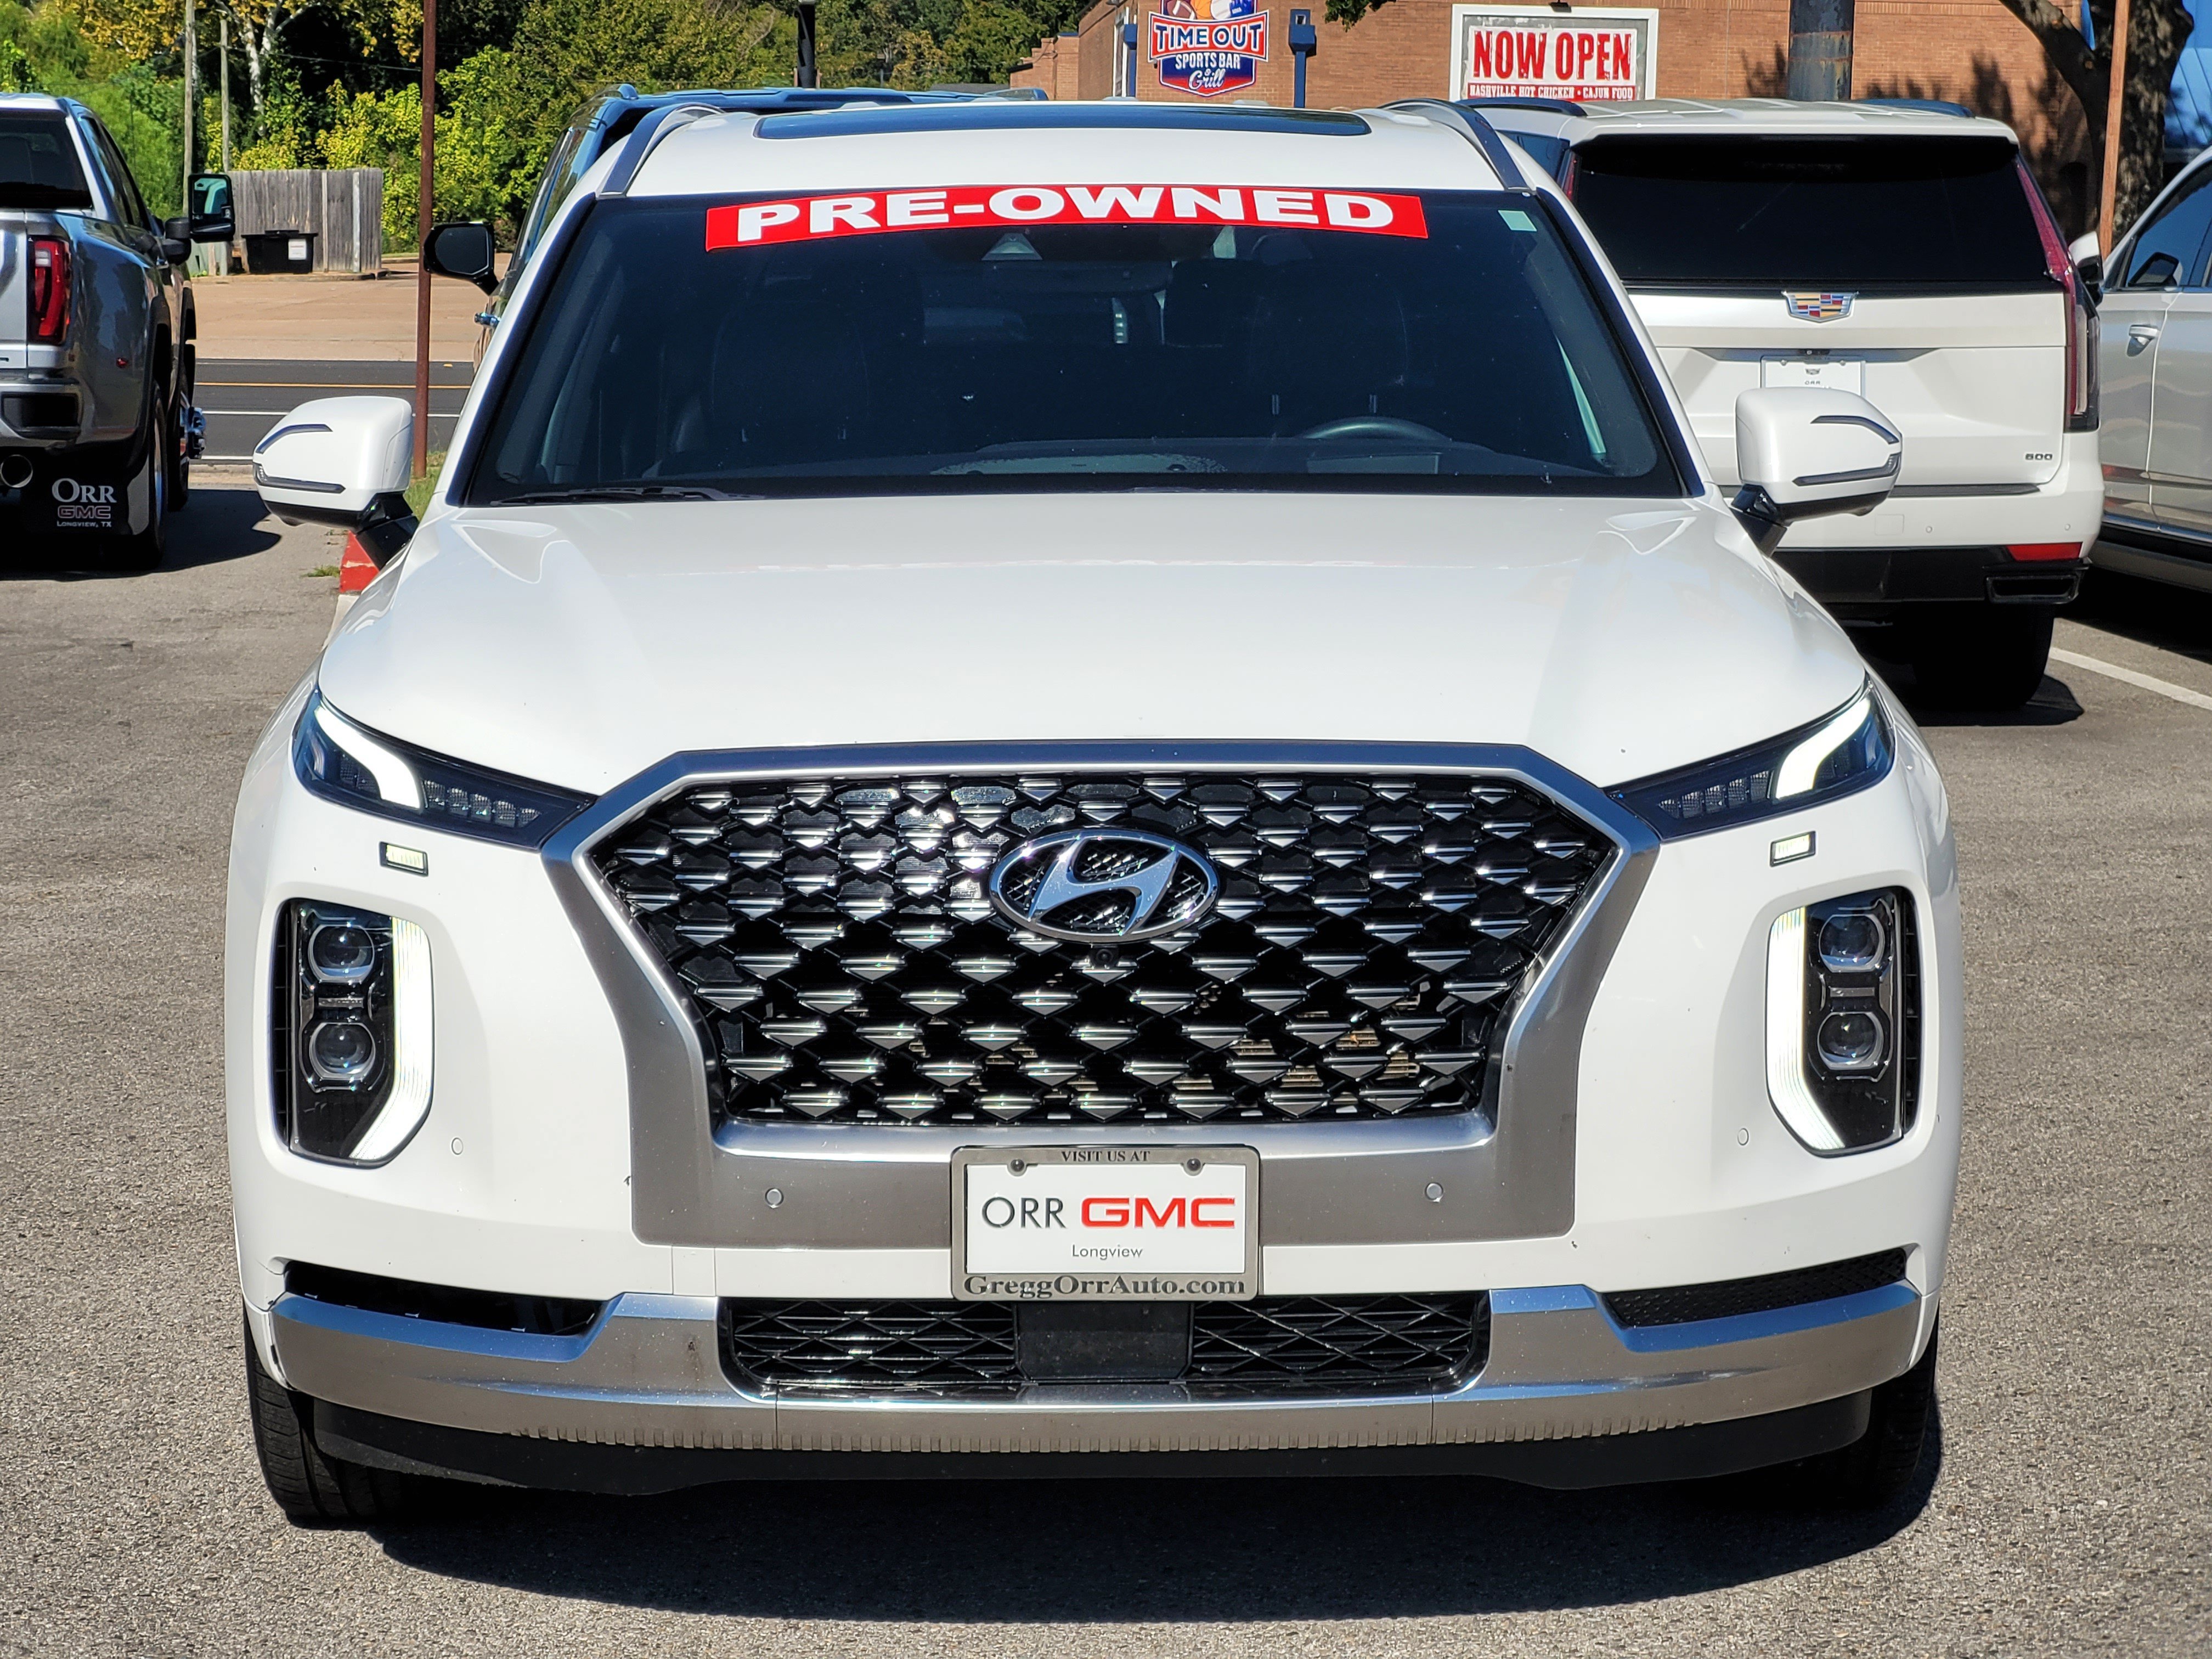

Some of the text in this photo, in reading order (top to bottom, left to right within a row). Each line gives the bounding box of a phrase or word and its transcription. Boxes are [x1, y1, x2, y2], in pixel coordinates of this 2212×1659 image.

[1155, 22, 1263, 52] TIME OUT
[1175, 53, 1241, 69] SPORTS BAR
[1473, 30, 1632, 81] NOW OPEN
[1188, 69, 1226, 89] Grill
[1470, 84, 1633, 99] NASHVILLE HOT CHICKEN CAJUN FOOD
[737, 185, 1394, 241] PRE-OWNED
[58, 505, 111, 519] GMC
[1061, 1150, 1150, 1162] VISIT US AT
[981, 1196, 1235, 1228] ORR GMC
[1072, 1244, 1143, 1260] Longview
[964, 1275, 1245, 1298] GreggOrrAuto.com
